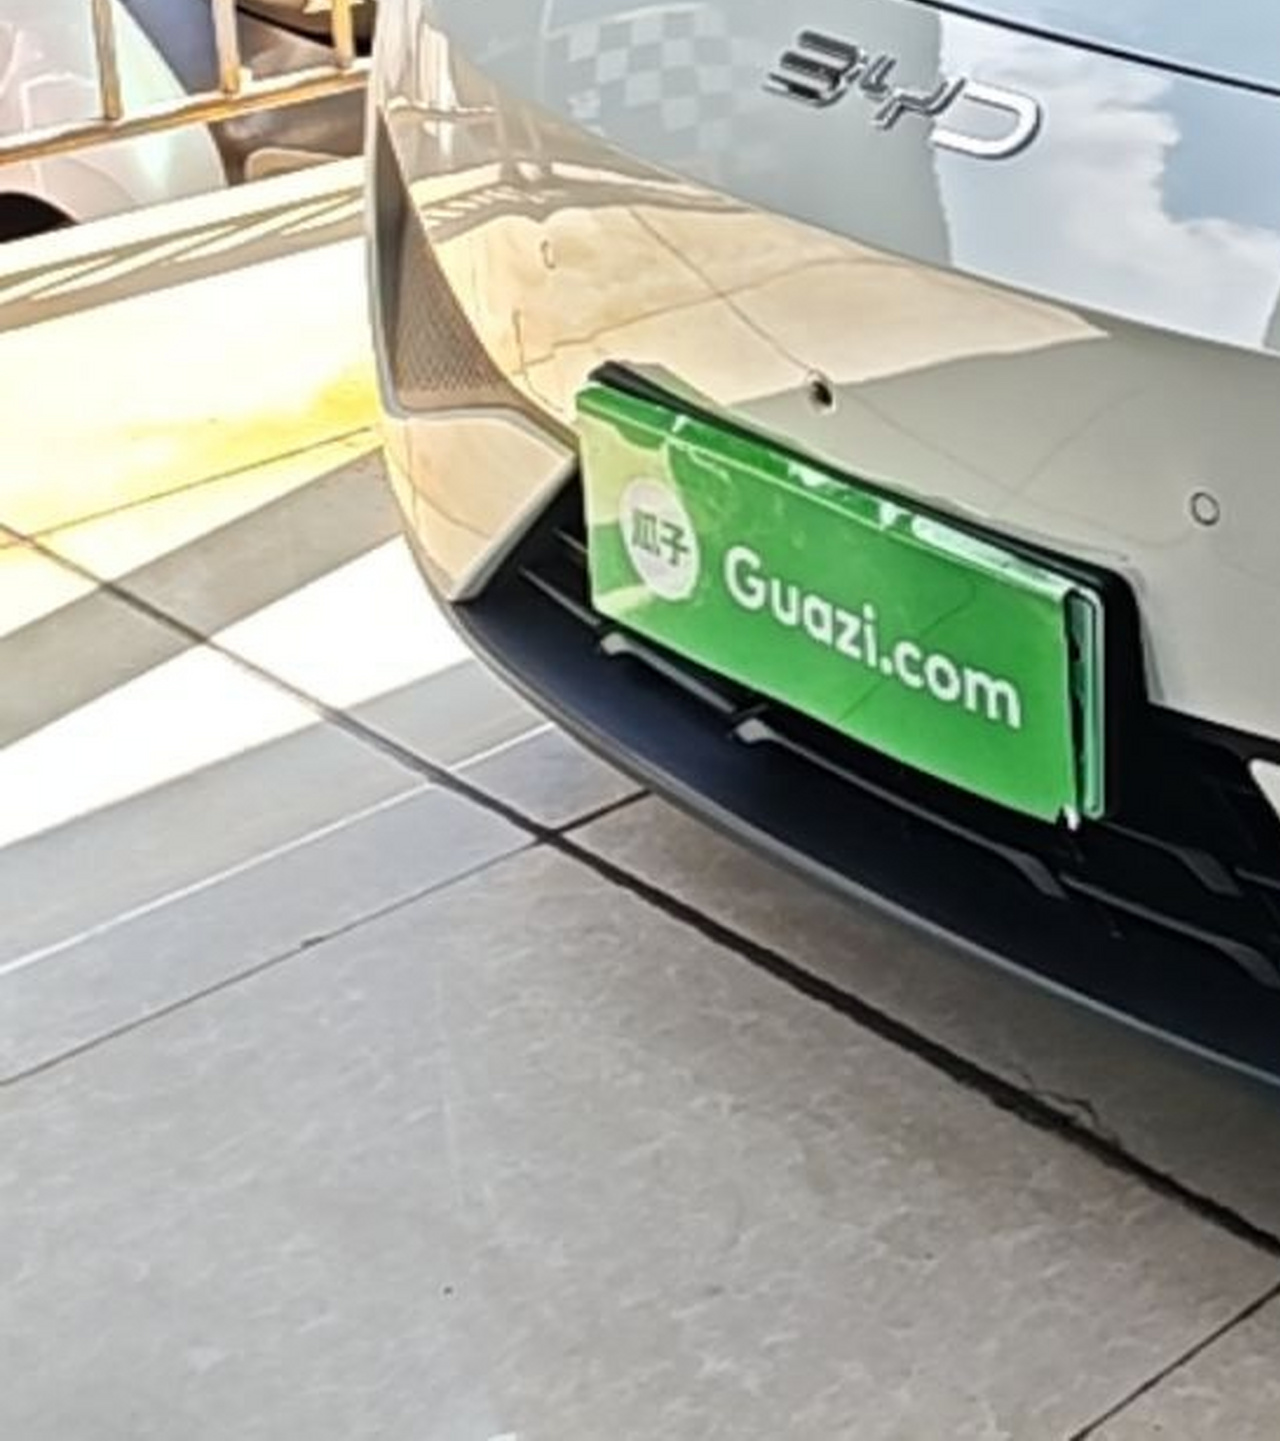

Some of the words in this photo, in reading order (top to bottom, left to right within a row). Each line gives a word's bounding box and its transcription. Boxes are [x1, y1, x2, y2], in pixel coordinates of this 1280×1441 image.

[762, 29, 1042, 161] BYD
[631, 506, 692, 570] 瓜子
[723, 545, 1022, 730] Guazi.com
